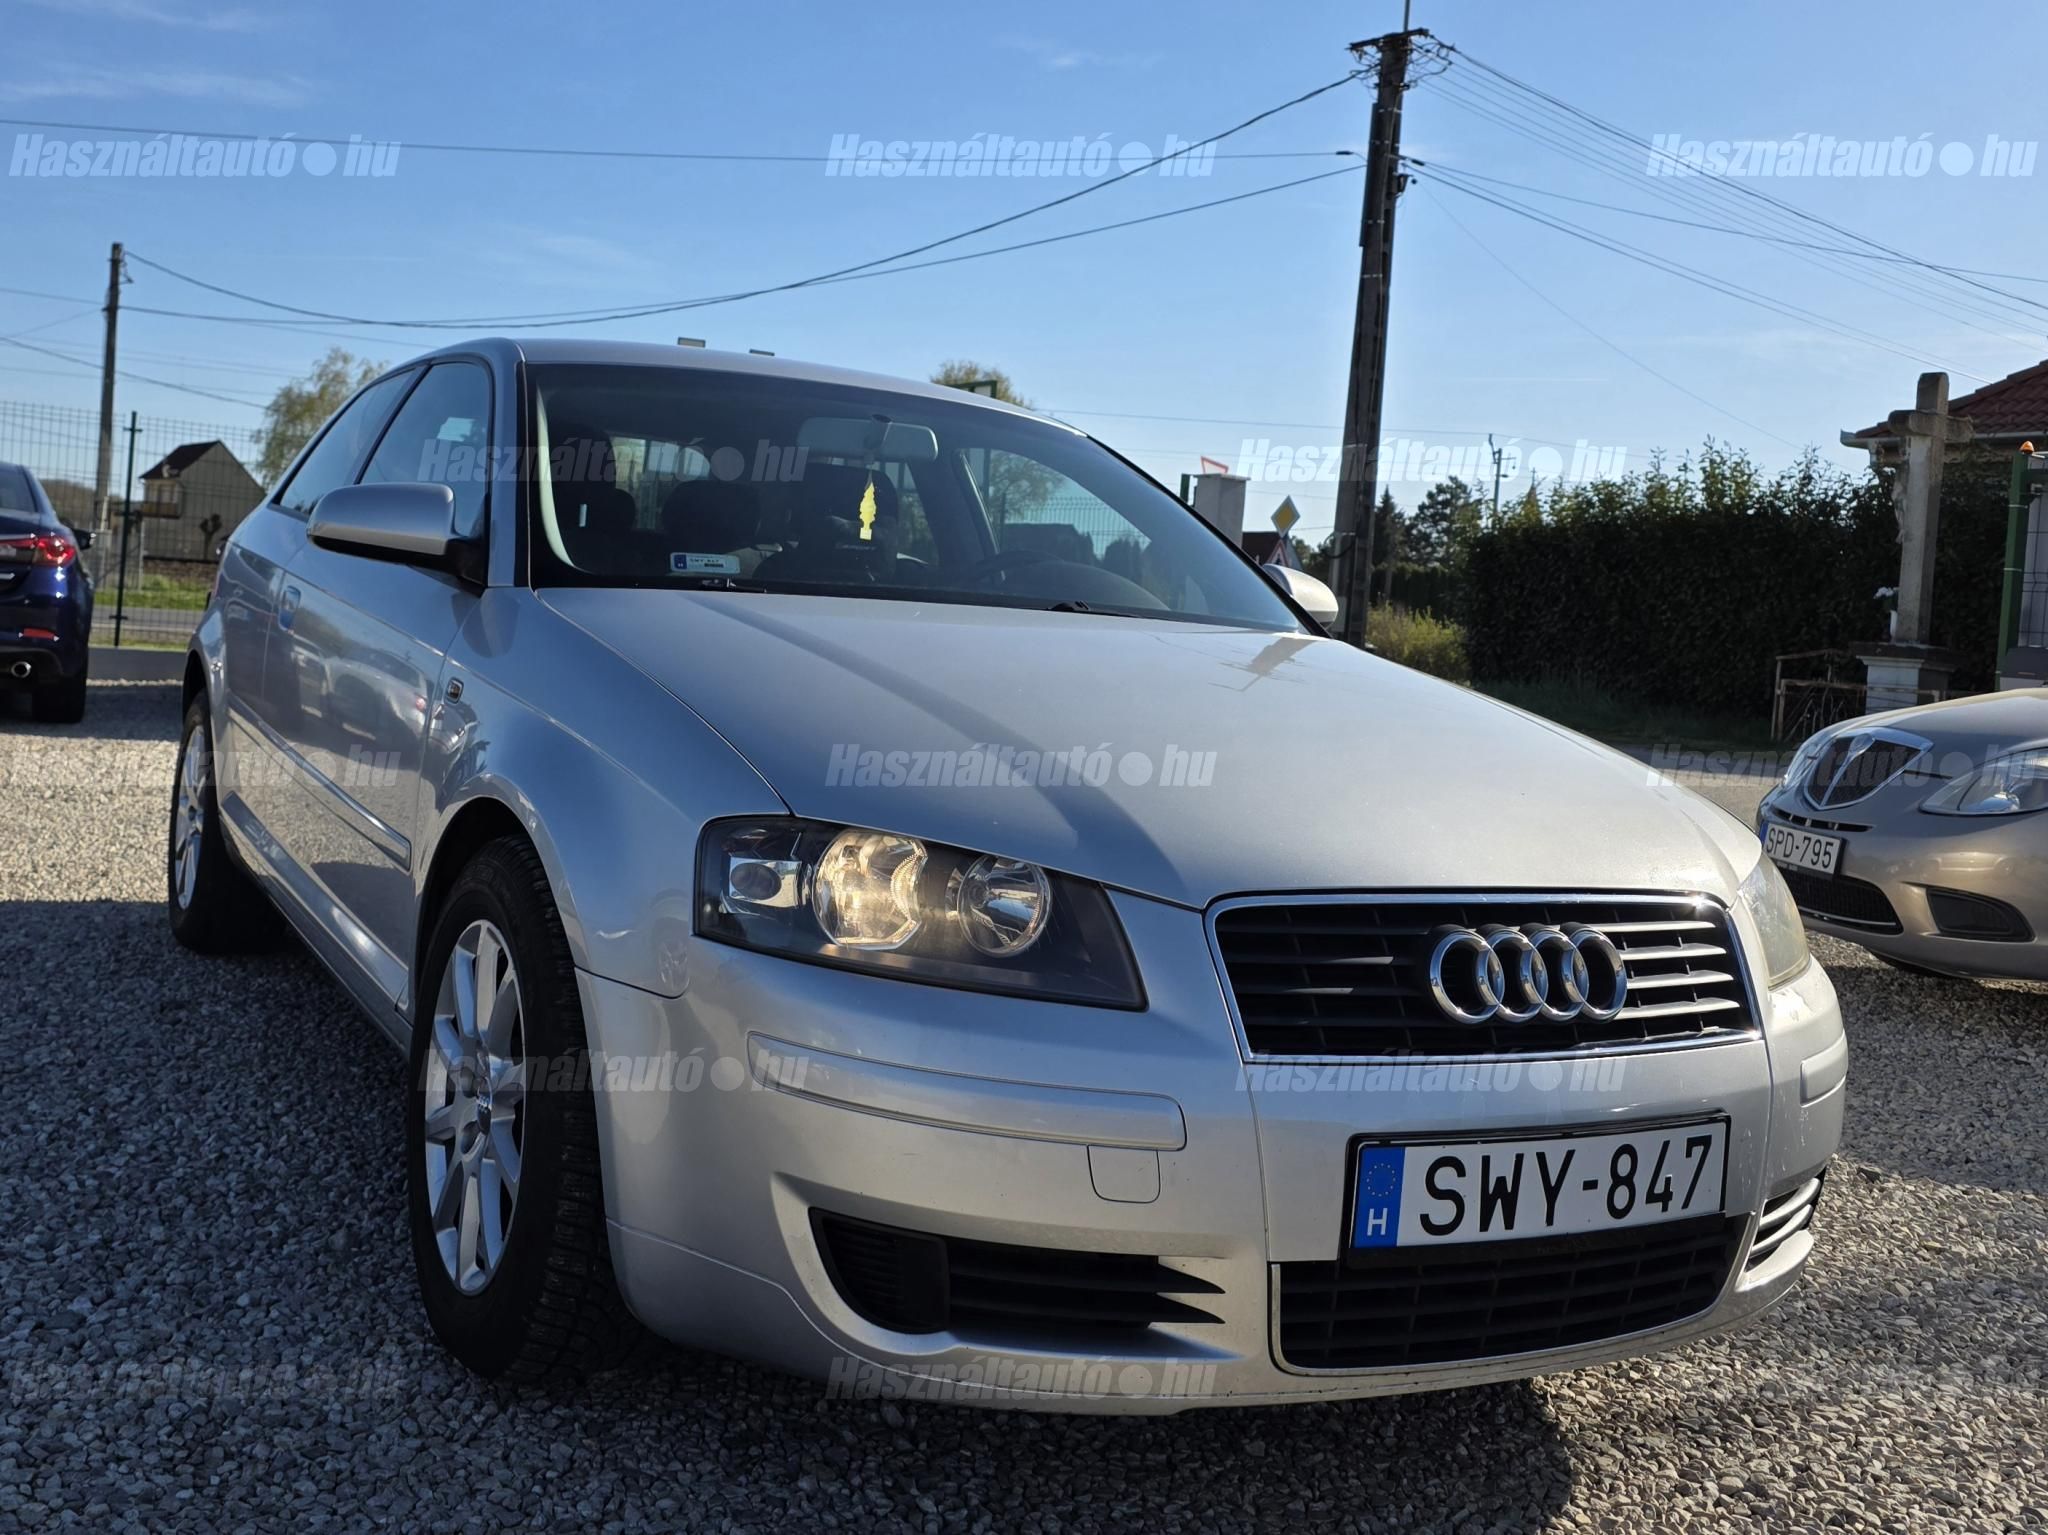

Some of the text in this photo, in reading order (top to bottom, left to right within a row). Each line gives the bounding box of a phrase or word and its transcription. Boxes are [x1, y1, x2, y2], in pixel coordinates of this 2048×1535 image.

[1766, 828, 1834, 869] SPD-795
[1419, 1134, 1713, 1236] SWY-847
[1366, 1207, 1388, 1236] H
